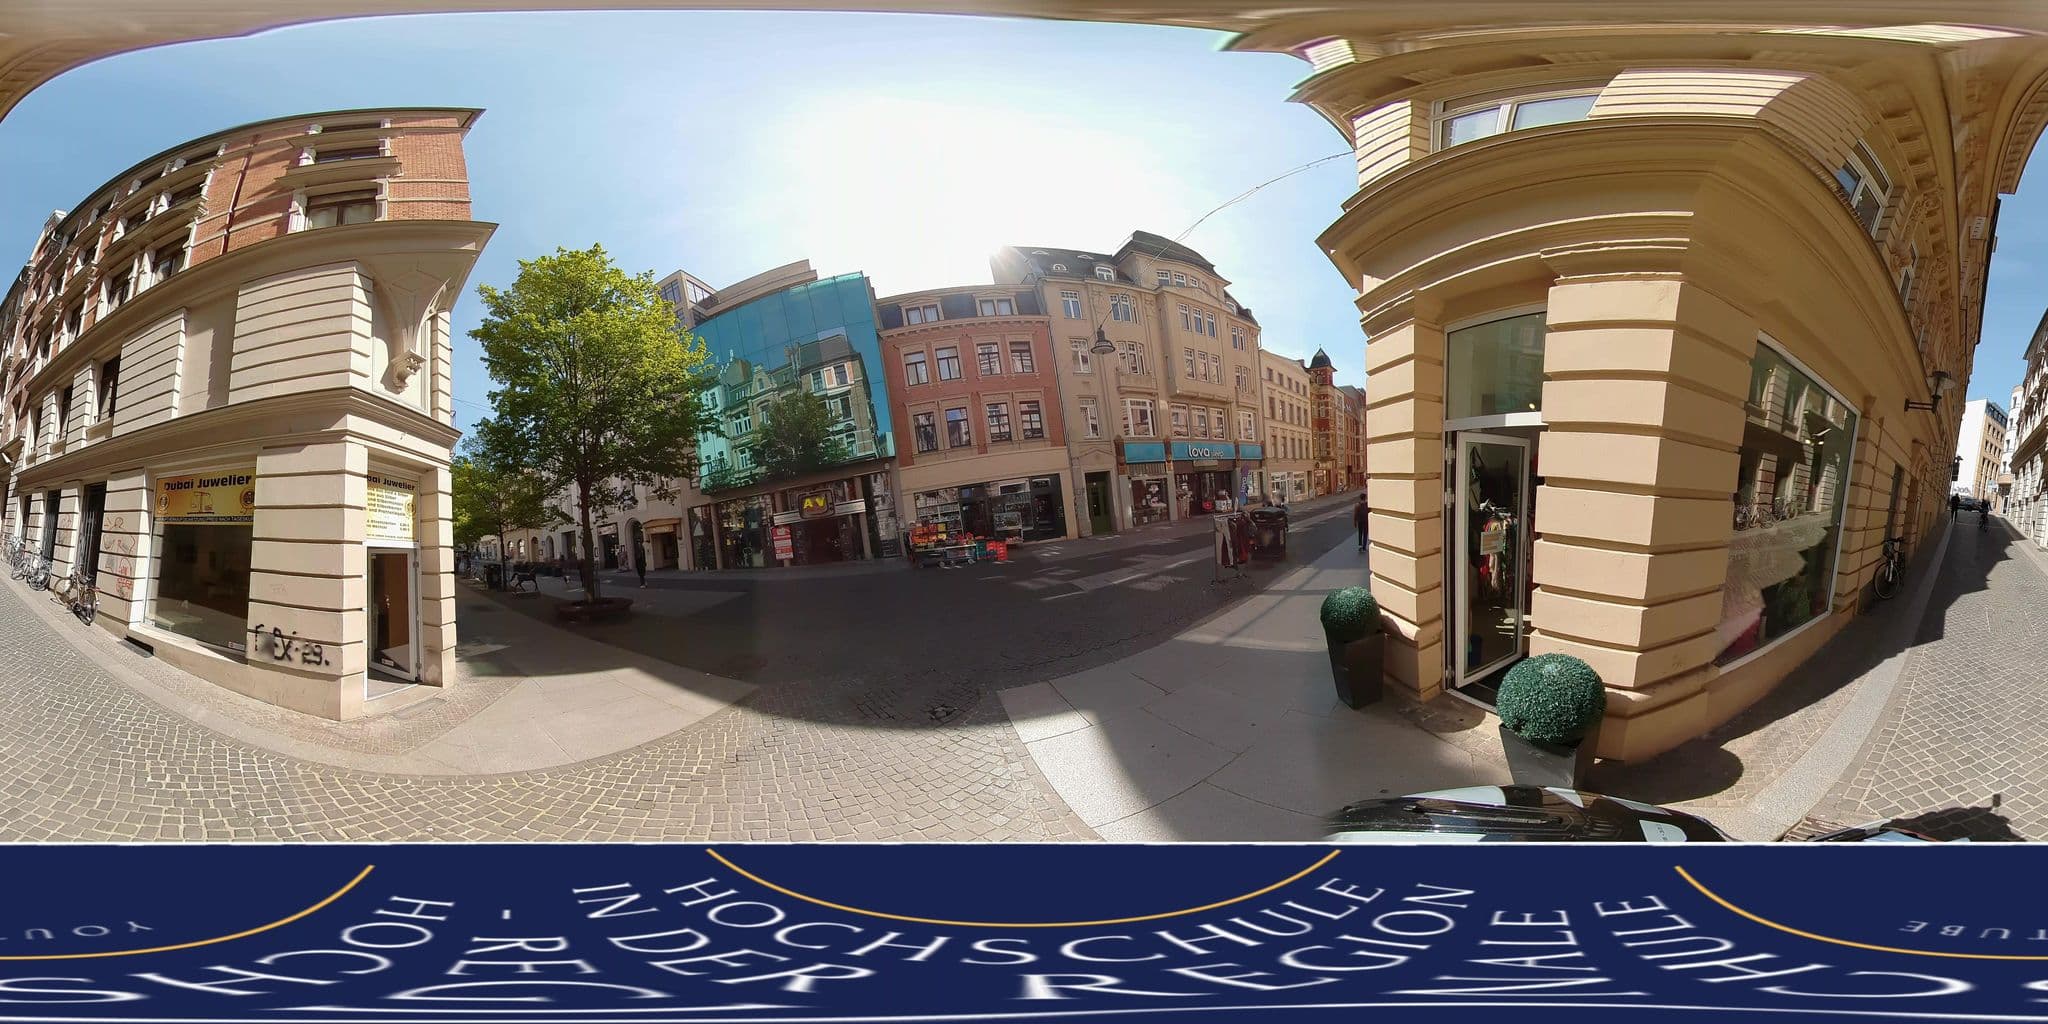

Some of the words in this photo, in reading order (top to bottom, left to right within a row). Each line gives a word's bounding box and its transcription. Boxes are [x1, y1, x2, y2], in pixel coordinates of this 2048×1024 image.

[1188, 444, 1210, 458] lova
[164, 478, 194, 491] Dubai
[197, 474, 252, 489] Juwelier
[383, 478, 415, 490] Juwelier
